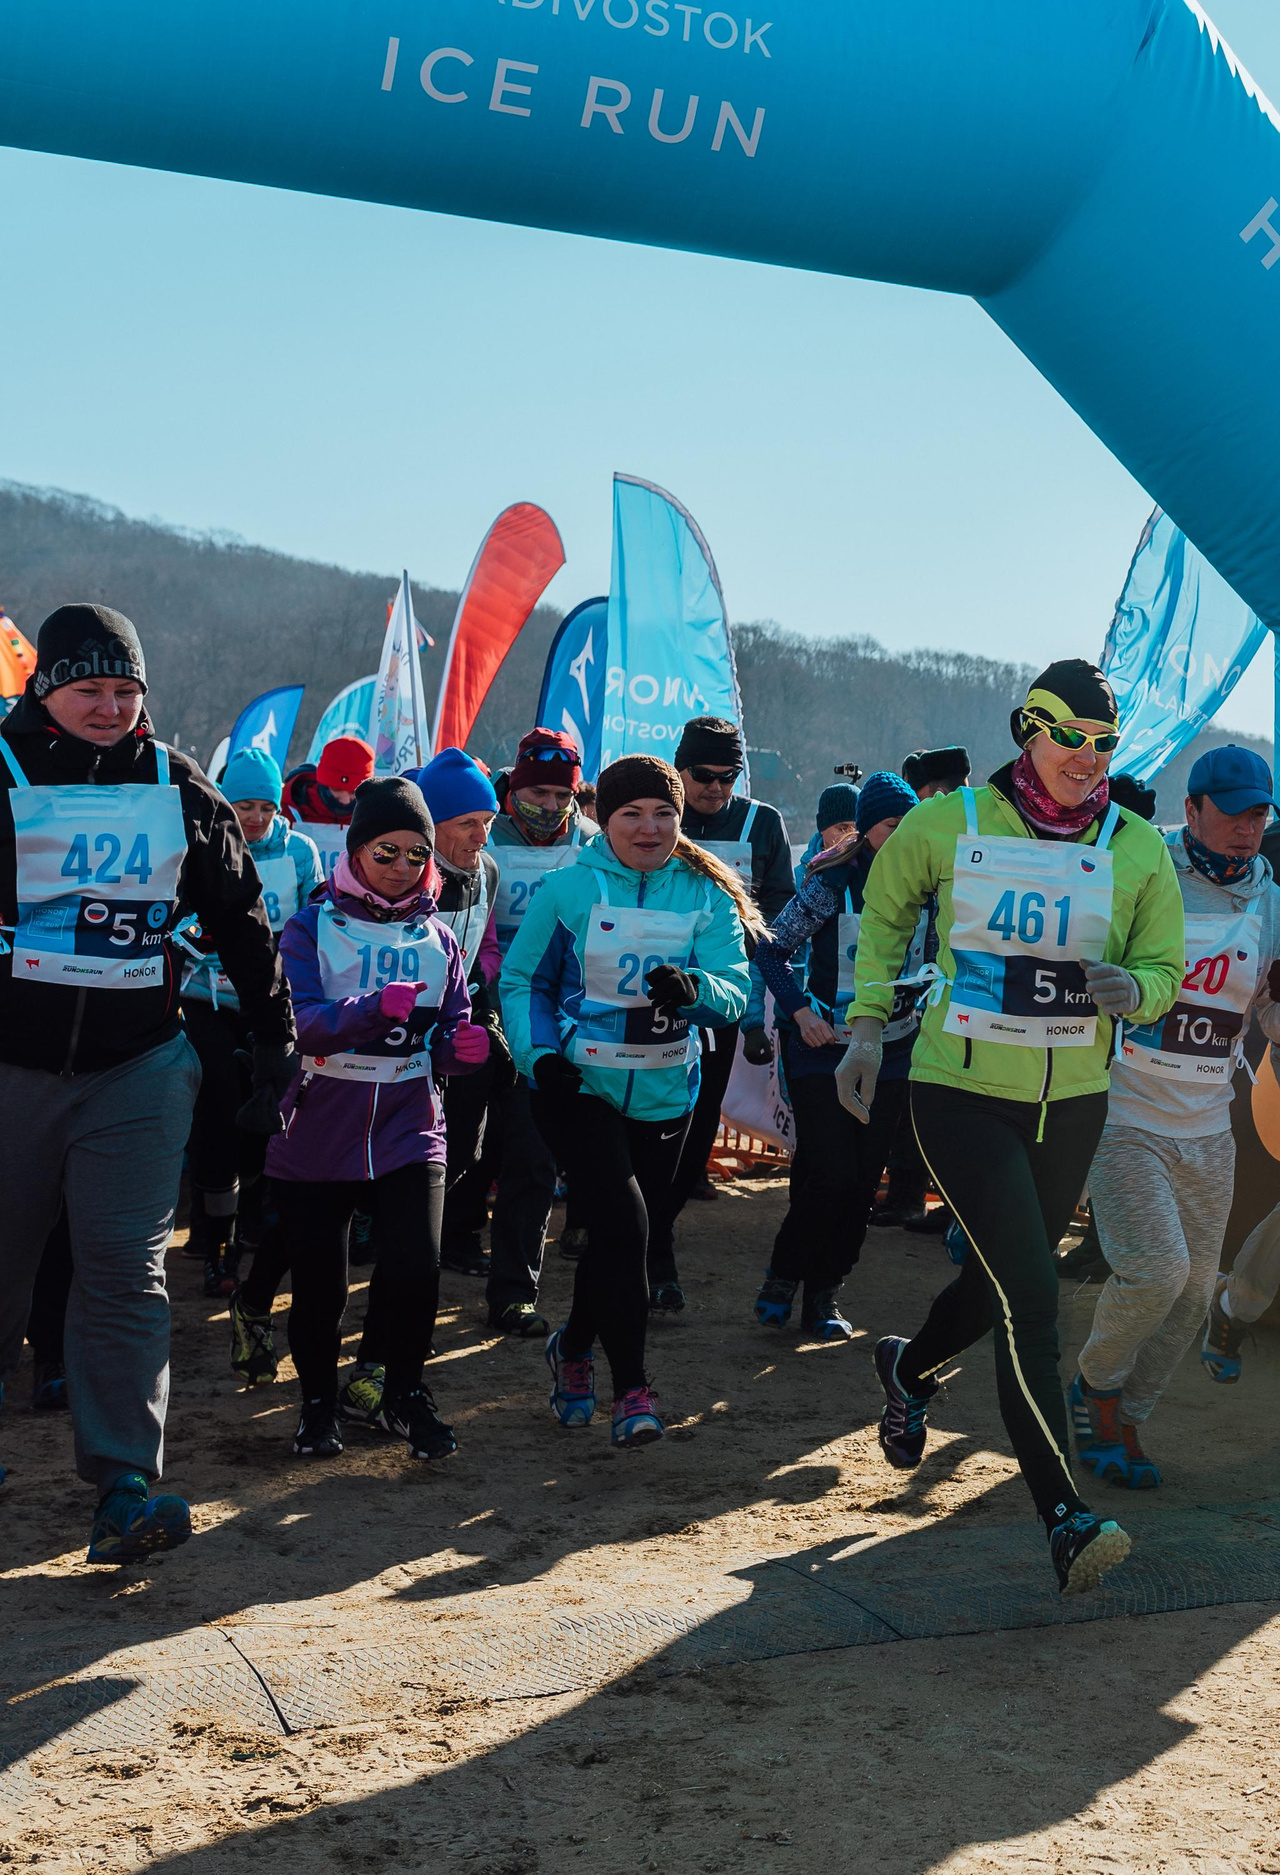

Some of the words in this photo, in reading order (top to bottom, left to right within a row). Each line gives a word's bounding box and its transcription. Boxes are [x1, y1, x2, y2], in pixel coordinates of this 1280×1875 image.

[381, 36, 539, 117] ICE
[580, 75, 765, 158] RUN
[61, 833, 152, 885] 424
[971, 850, 982, 863] D
[109, 913, 137, 946] 5
[142, 931, 162, 946] km
[153, 908, 162, 922] C
[987, 890, 1071, 946] 461
[124, 966, 157, 978] HONOR
[357, 944, 420, 989] 199
[1033, 969, 1057, 1004] 5
[1064, 989, 1091, 1004] km
[651, 1007, 669, 1034] 5
[673, 1018, 687, 1031] km
[1046, 1025, 1085, 1036] HONOR
[1177, 1014, 1213, 1045] 10
[1212, 1033, 1228, 1047] km
[1196, 1064, 1224, 1074] HONOR
[773, 1104, 791, 1137] ICE
